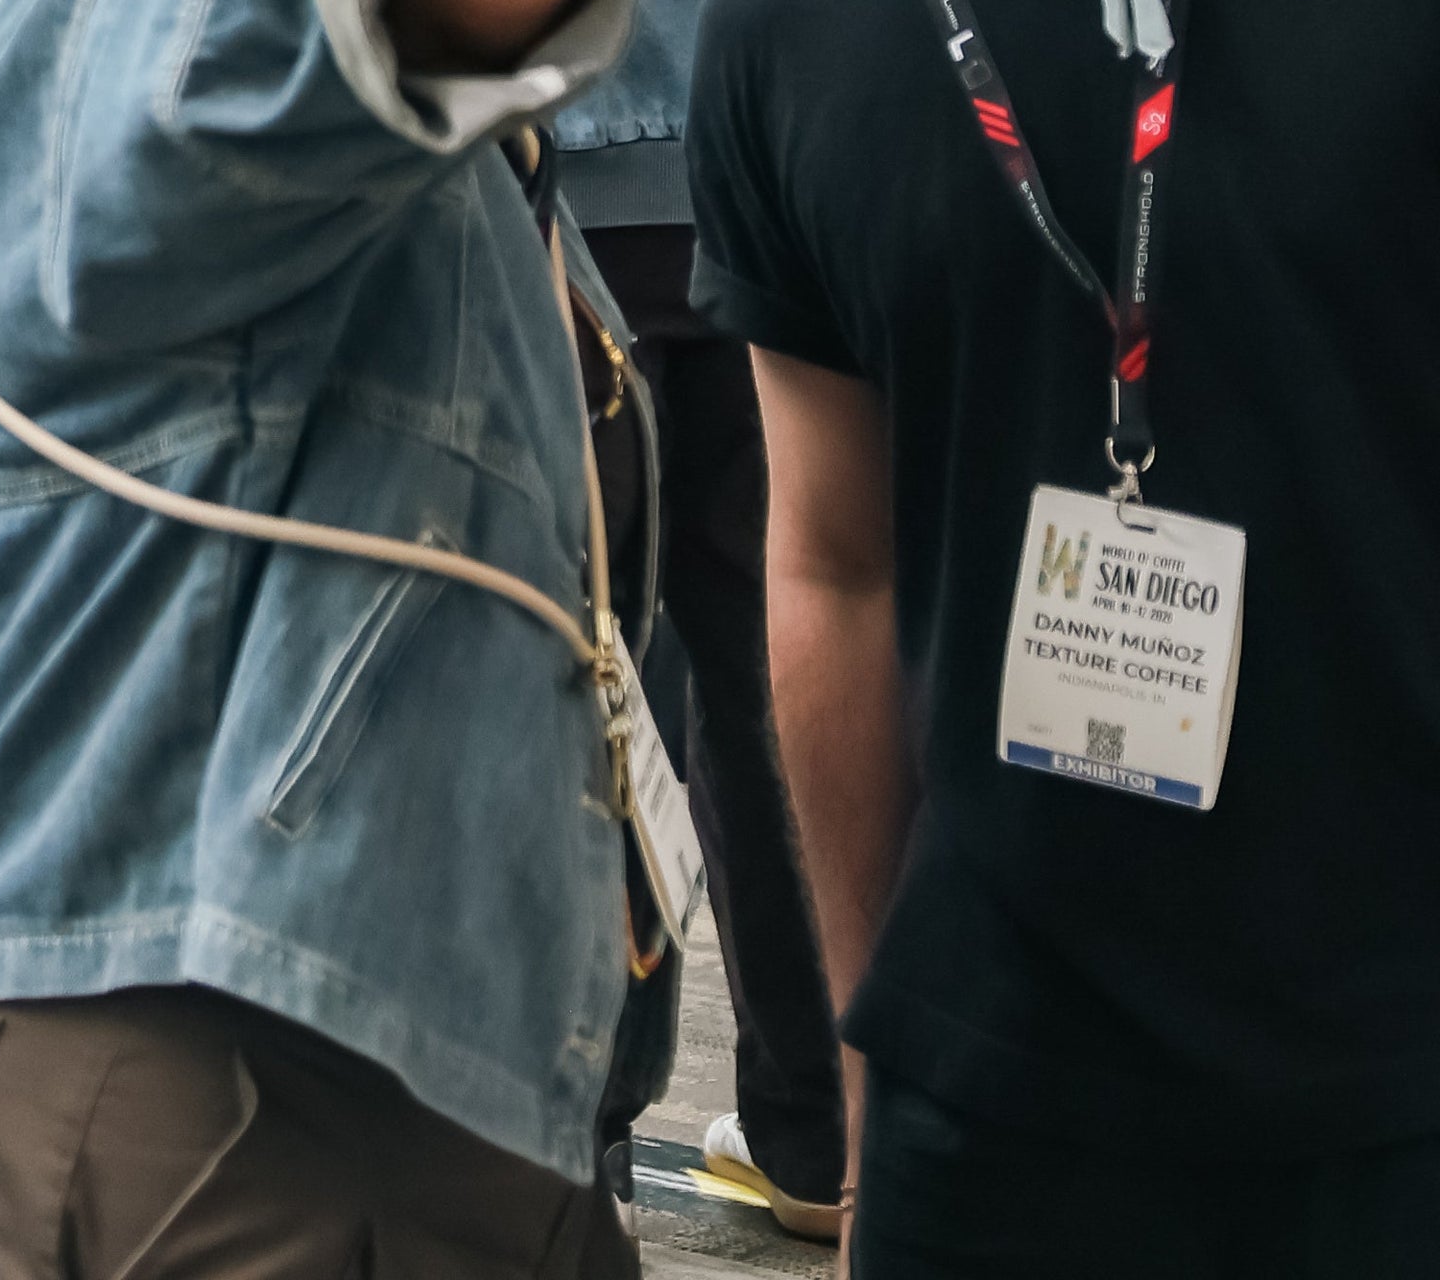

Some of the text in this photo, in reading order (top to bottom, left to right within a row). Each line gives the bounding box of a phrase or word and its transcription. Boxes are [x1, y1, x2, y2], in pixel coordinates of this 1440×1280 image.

[1135, 171, 1155, 304] STRONGHOLD
[1101, 543, 1135, 561] WORLD
[1091, 594, 1119, 609] APRIL
[1095, 561, 1221, 615] SAN DIEGO
[1024, 638, 1209, 695] TEXTURE COFFEE
[1035, 612, 1207, 667] DANNY MUÑOZ
[1053, 754, 1157, 791] EXHIBITOR
